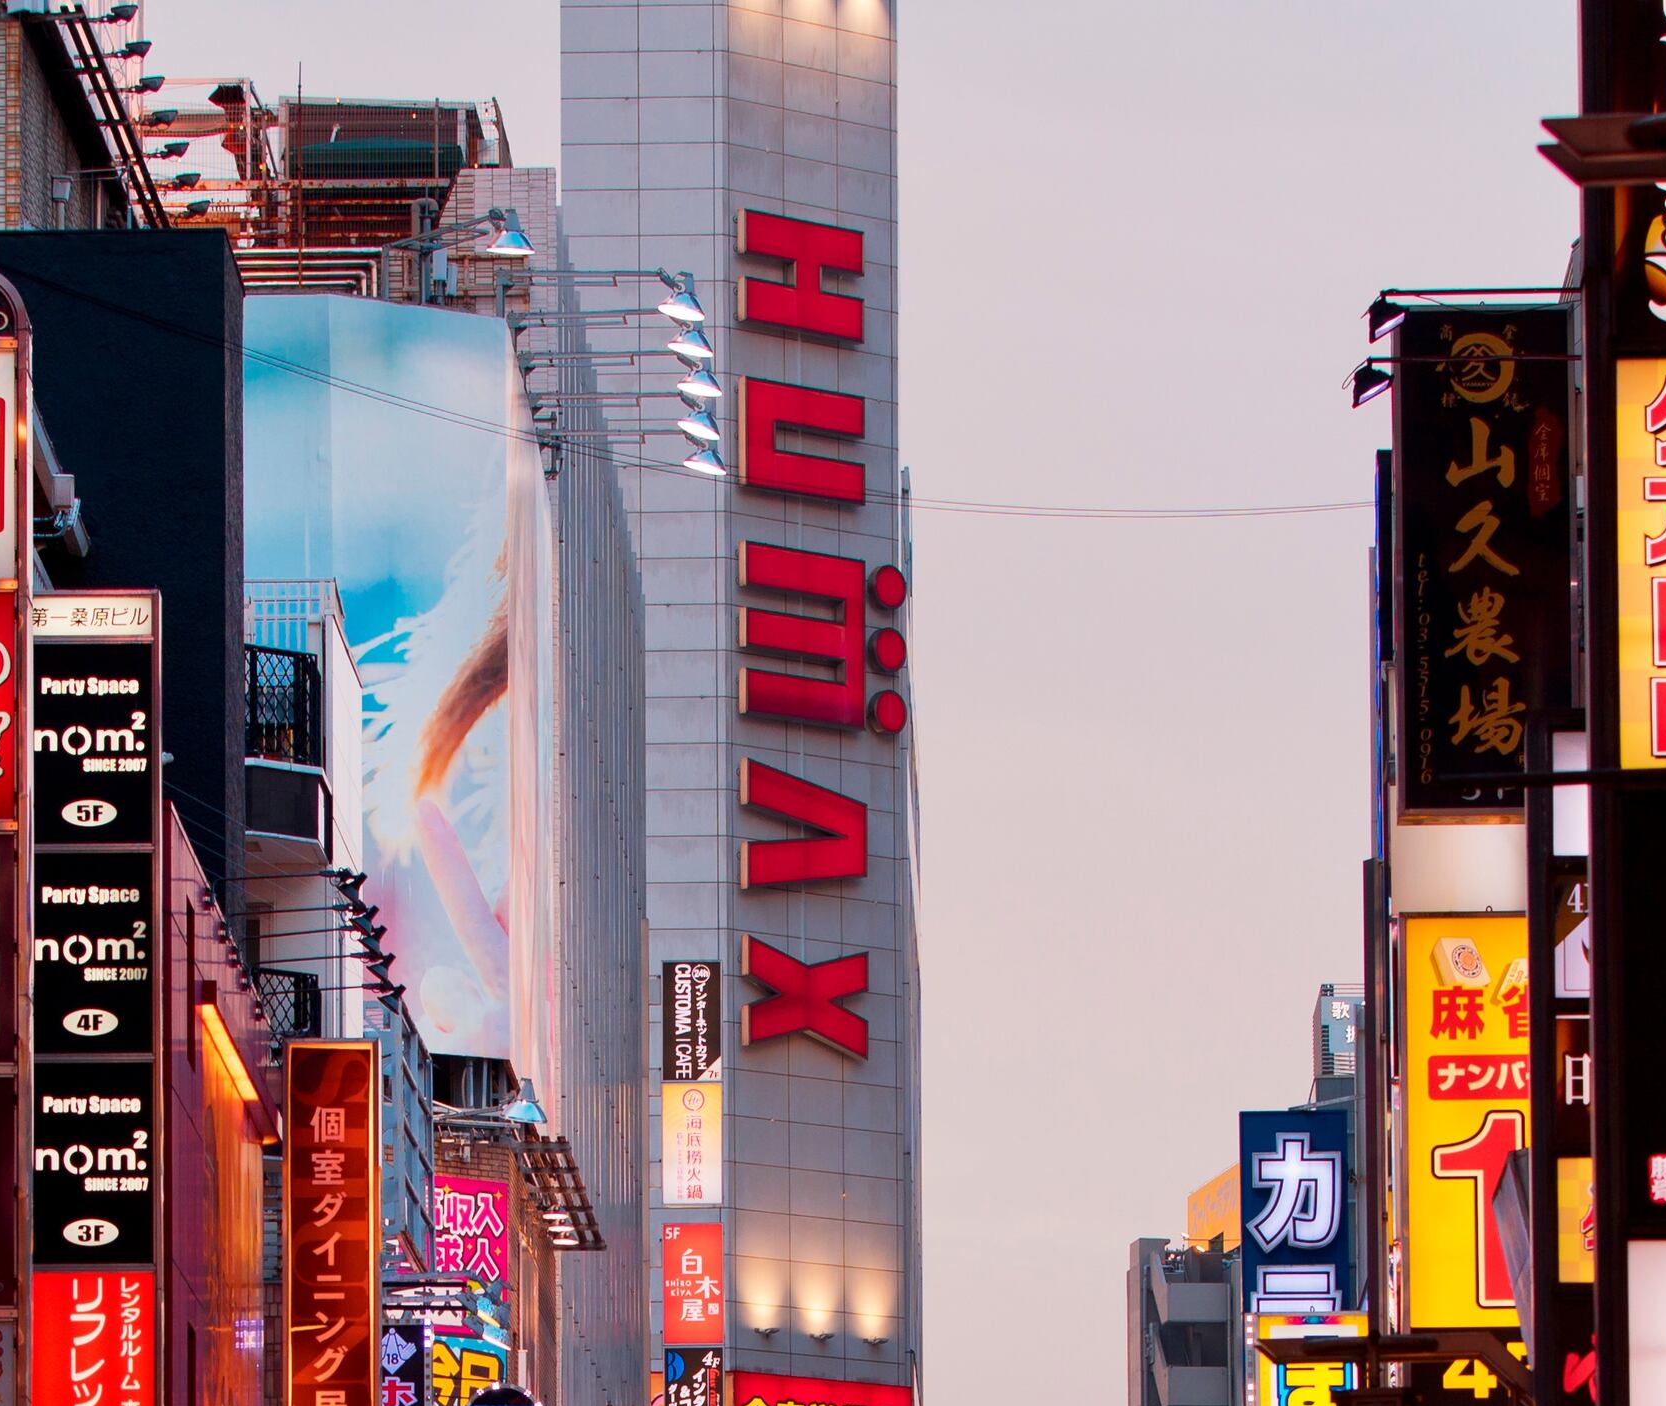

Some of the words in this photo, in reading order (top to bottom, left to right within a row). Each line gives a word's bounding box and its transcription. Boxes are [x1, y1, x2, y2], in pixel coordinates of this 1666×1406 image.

[1445, 417, 1528, 755] 山久農場
[32, 607, 150, 628] 第一桑原ビル
[41, 678, 86, 696] Party
[87, 678, 139, 696] Space
[83, 758, 116, 773] SINCE
[118, 758, 147, 773] 2007
[76, 805, 104, 823] 5F
[42, 887, 87, 905] Party
[88, 887, 140, 905] Space
[84, 967, 117, 982] SINCE
[119, 967, 148, 982] 2007
[674, 964, 692, 1037] CUSTOMA
[76, 1014, 103, 1032] 4F
[695, 983, 708, 1071] インターネットカフェ
[675, 1043, 693, 1080] CAFE
[43, 1096, 86, 1114] Party
[88, 1097, 141, 1114] Space
[84, 1177, 117, 1192] SINCE
[119, 1177, 148, 1192] 2007
[77, 1224, 104, 1242] 3F
[665, 1227, 680, 1240] 5F
[119, 1276, 142, 1390] レンタルルーム
[702, 1351, 721, 1368] 4F
